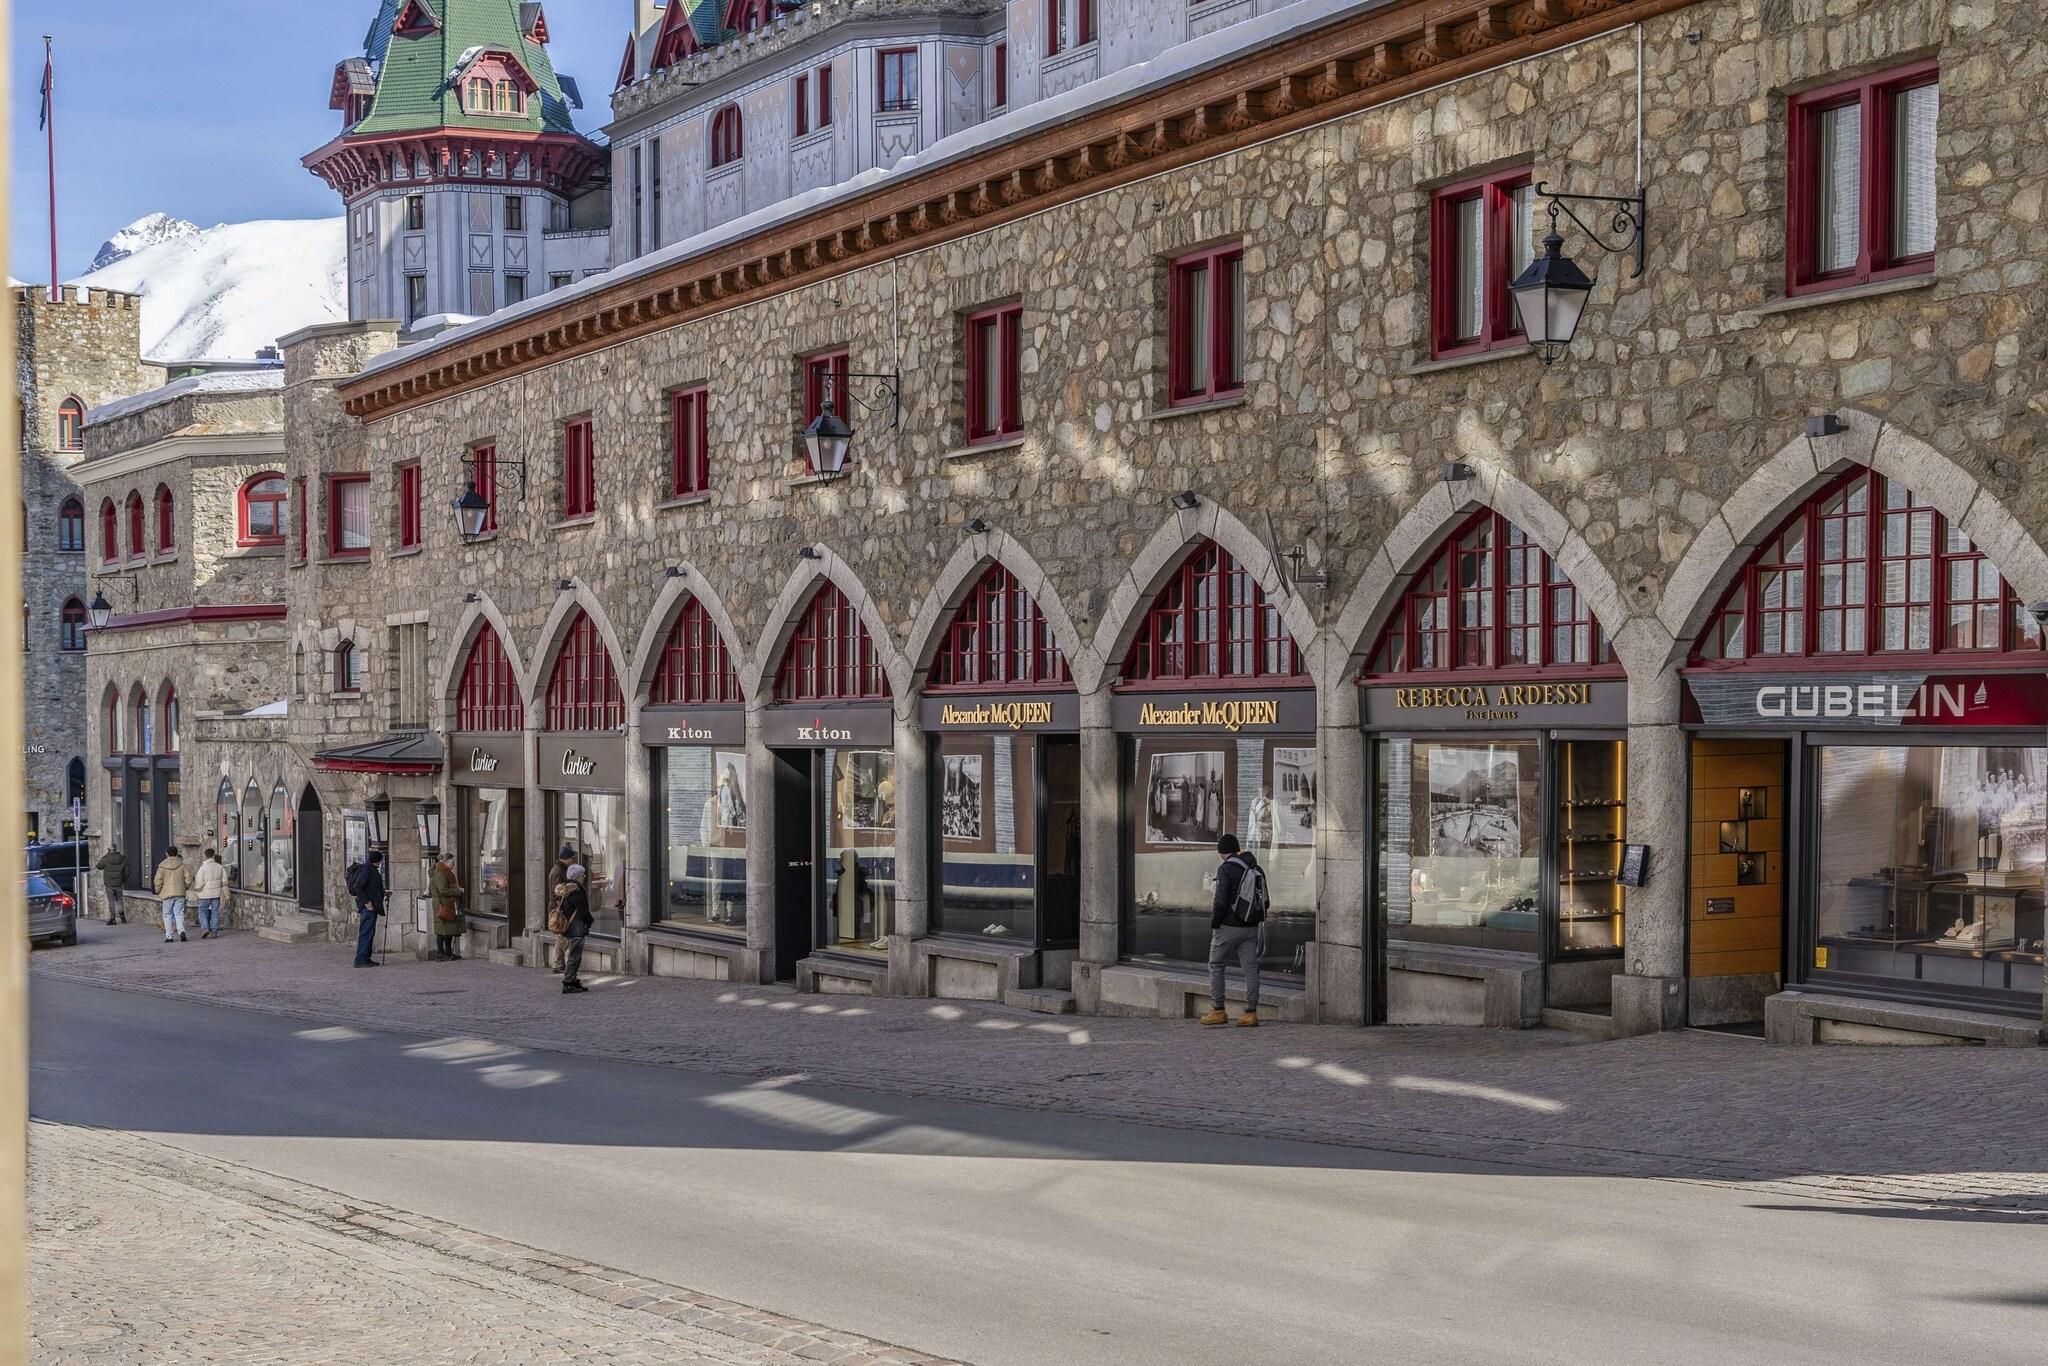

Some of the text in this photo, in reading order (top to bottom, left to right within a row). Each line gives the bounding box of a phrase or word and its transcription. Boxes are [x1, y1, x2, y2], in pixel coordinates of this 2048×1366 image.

[1396, 684, 1590, 707] REBECCA ARDESSI
[1756, 684, 1965, 717] GÜBELIN
[941, 702, 1051, 729] Alexander McQUEEN
[1139, 700, 1278, 731] Alexander McQUEEN
[668, 720, 712, 739] Kiton
[797, 719, 851, 740] Kiton
[471, 747, 497, 772] Cartier
[562, 749, 594, 775] Cartier
